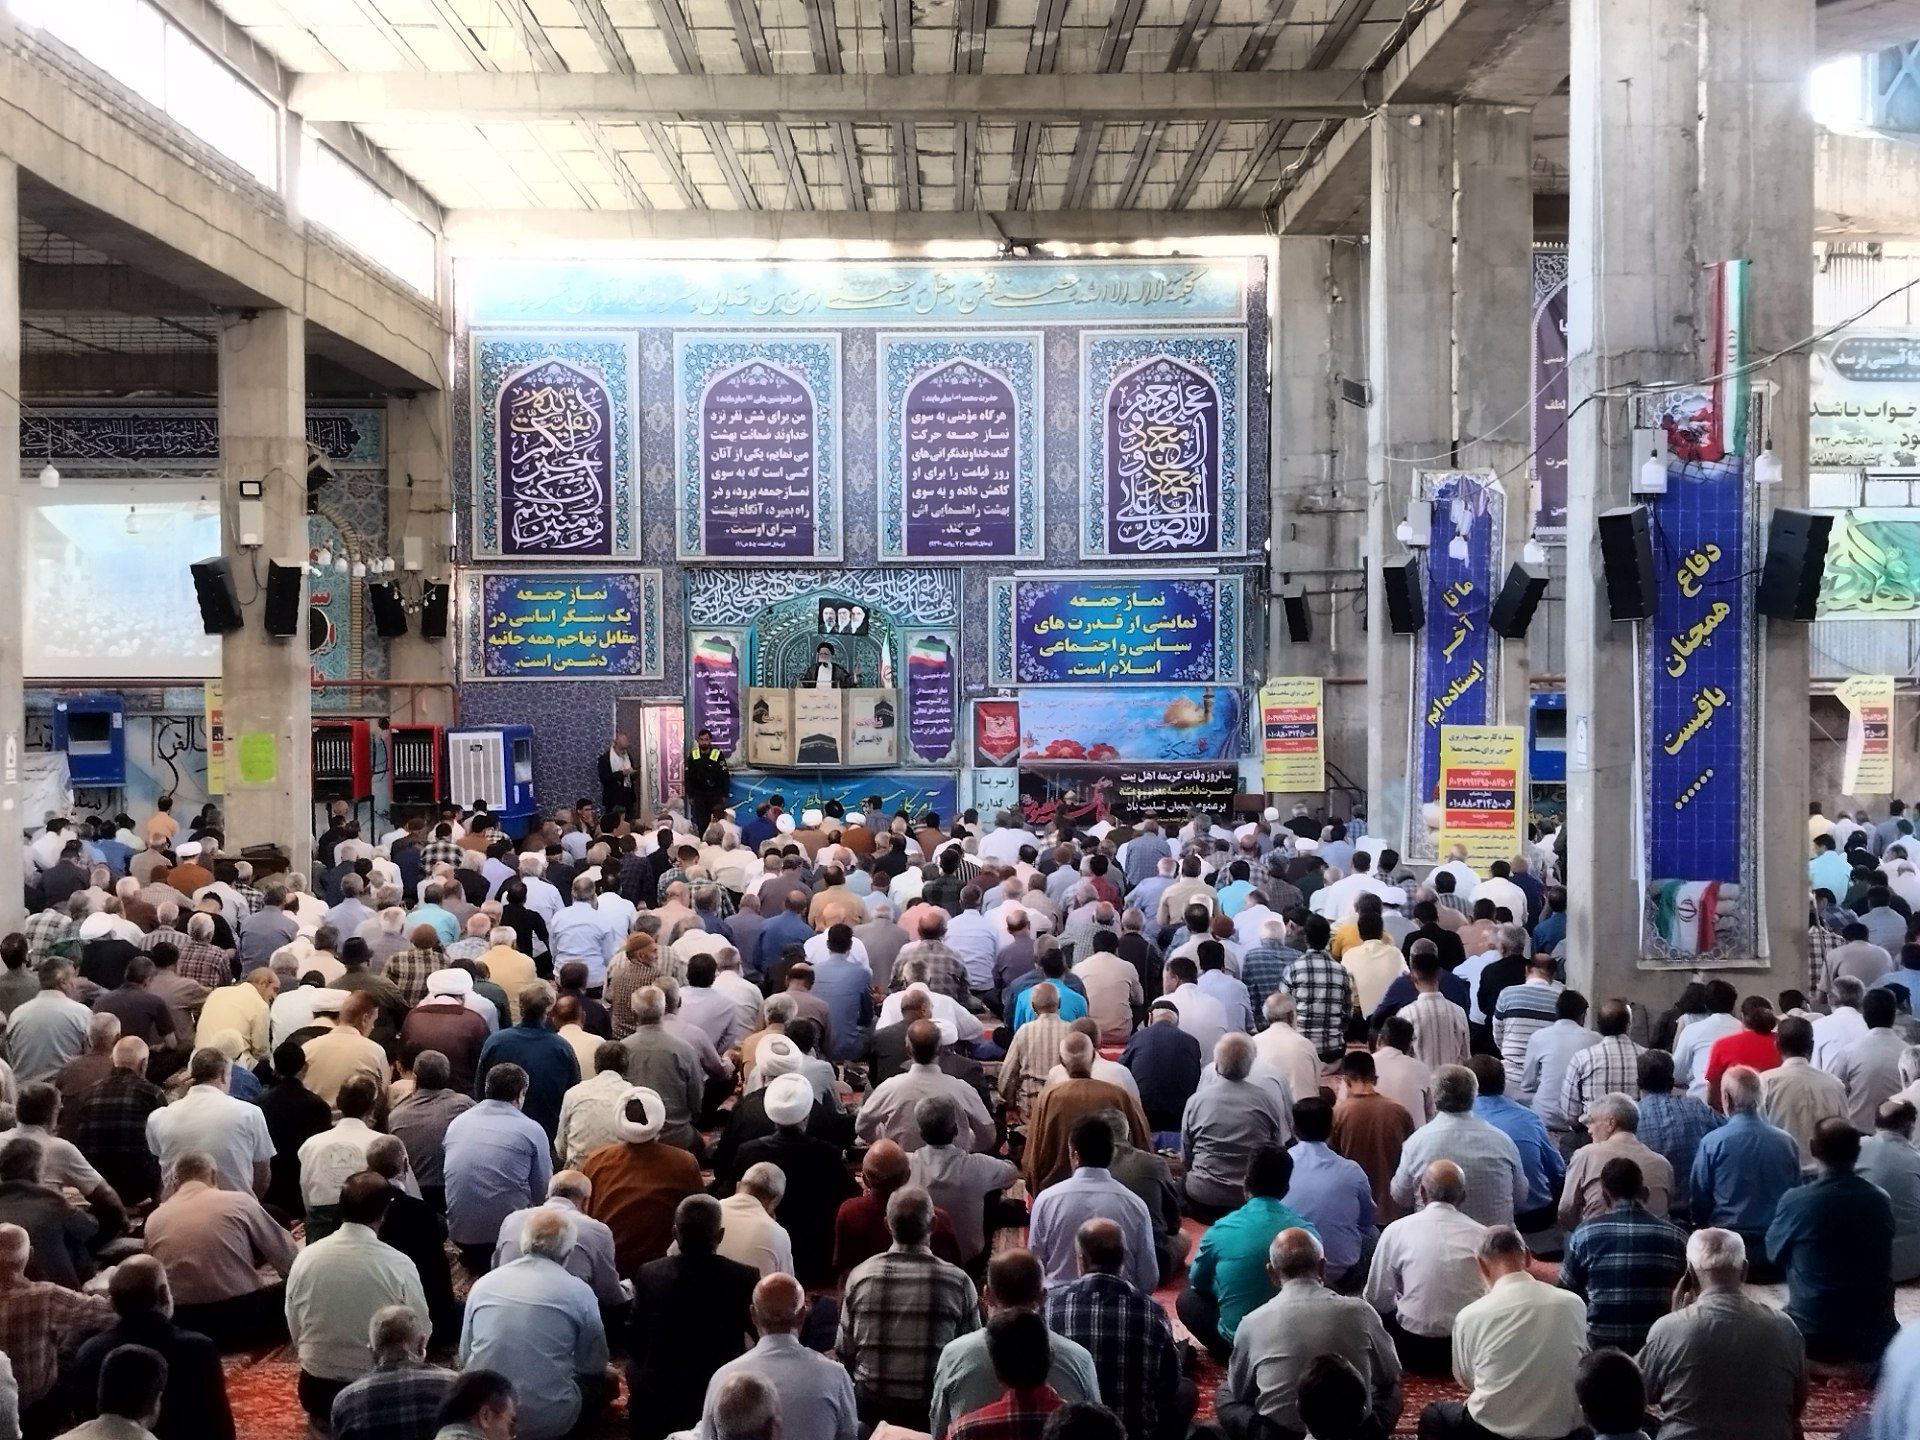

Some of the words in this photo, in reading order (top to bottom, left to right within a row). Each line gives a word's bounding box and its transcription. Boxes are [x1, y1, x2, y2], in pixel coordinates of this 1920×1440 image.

[710, 409, 726, 424] نزد
[728, 410, 743, 424] نفر
[744, 410, 766, 424] شش
[767, 410, 790, 425] برای
[791, 412, 806, 424] من
[935, 411, 946, 424] به
[947, 408, 978, 424] مؤمنی
[979, 409, 995, 421] گاه
[994, 411, 1006, 424] هر
[1809, 401, 1861, 422] باشد
[1864, 400, 1918, 423] خواب
[911, 414, 934, 424] سوی
[710, 429, 737, 442] بهشت
[740, 428, 772, 440] ضمانت
[774, 428, 808, 443] خداوند
[911, 428, 942, 443] حرکت
[946, 431, 979, 442] جمعه
[982, 427, 1009, 443] نماز
[710, 446, 732, 461] آنان
[733, 448, 743, 462] از
[743, 448, 764, 462] یکی
[793, 451, 809, 462] می
[711, 470, 734, 480] سوی
[735, 468, 746, 480] به
[747, 466, 760, 477] که
[762, 466, 784, 478] است
[785, 466, 809, 480] کسی
[911, 466, 921, 480] او
[923, 466, 946, 480] برای
[949, 466, 959, 480] را
[961, 464, 990, 479] قیامت
[992, 469, 1010, 480] روز
[711, 486, 723, 499] در
[724, 491, 731, 499] و
[758, 487, 783, 499] جمعه
[782, 485, 809, 499] نماز
[911, 489, 935, 499] سوی
[936, 487, 947, 498] به
[948, 489, 955, 499] و
[956, 485, 979, 495] داده
[980, 484, 1010, 499] کاهش
[711, 504, 738, 518] بهشت
[739, 503, 764, 515] آنگاه
[795, 504, 809, 518] راه
[930, 503, 981, 518] راهنمایی
[983, 504, 1010, 517] بهشت
[766, 523, 797, 537] برای
[965, 525, 981, 536] می
[1676, 543, 1722, 599] دفاع
[568, 585, 608, 605] نماز
[1454, 579, 1474, 597] ما
[516, 587, 566, 604] جمعه
[1069, 593, 1123, 611] جمعه
[1126, 591, 1166, 612] نماز
[1440, 588, 1459, 607] تا
[488, 611, 506, 628] در
[508, 608, 556, 627] اساسی
[558, 609, 606, 627] سنگر
[607, 608, 631, 627] یک
[1033, 614, 1066, 634] های
[1125, 615, 1140, 634] از
[1142, 614, 1198, 634] نمایشی
[1067, 615, 1124, 635] قدرت
[488, 630, 525, 650] جانبه
[527, 632, 555, 644] همه
[557, 630, 597, 649] تهاجم
[599, 630, 637, 649] مقابل
[1442, 612, 1475, 665] آخر
[1665, 602, 1732, 679] همچنان
[1039, 637, 1117, 657] اجتماعی
[1119, 644, 1127, 657] و
[1128, 636, 1193, 657] سیاسی
[553, 652, 608, 671] دشمن
[1109, 659, 1162, 679] اسلام
[1442, 659, 1486, 709] ایستاده
[1427, 695, 1447, 729] ایم
[1664, 687, 1732, 756] باقیست
[1120, 773, 1137, 782] بیت
[1137, 771, 1156, 783] اهل
[1183, 769, 1205, 782] وفات
[1206, 770, 1232, 782] سالروز
[1126, 801, 1139, 813] باد
[1139, 801, 1167, 811] تسلیت
[1218, 803, 1227, 812] بر
